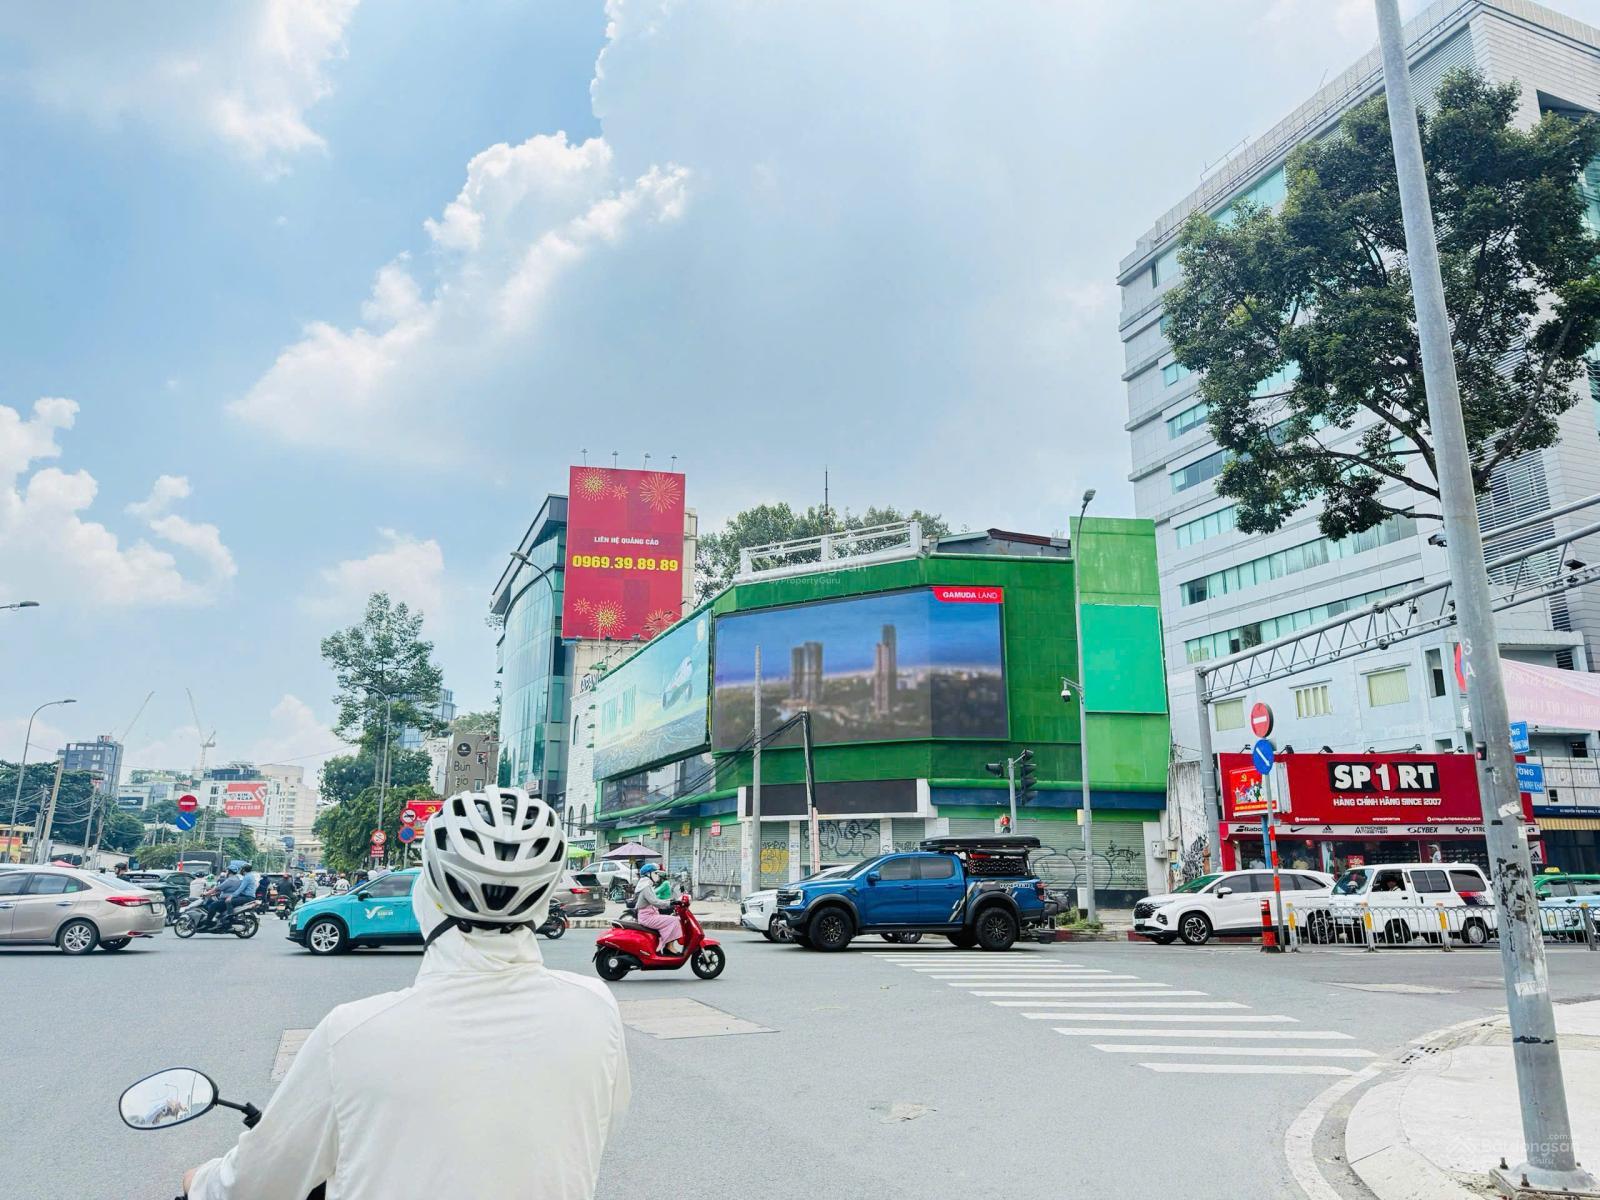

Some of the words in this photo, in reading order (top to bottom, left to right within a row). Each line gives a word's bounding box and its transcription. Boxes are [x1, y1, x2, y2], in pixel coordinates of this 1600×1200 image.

[572, 555, 678, 571] 0969.39.89.89
[942, 591, 977, 599] GAMUDA
[1333, 796, 1356, 806] HÀNG
[1356, 796, 1379, 806] CHÍNH
[1379, 796, 1401, 806] HÃNG
[1401, 798, 1423, 806] SINCE
[1423, 798, 1442, 806] 2007
